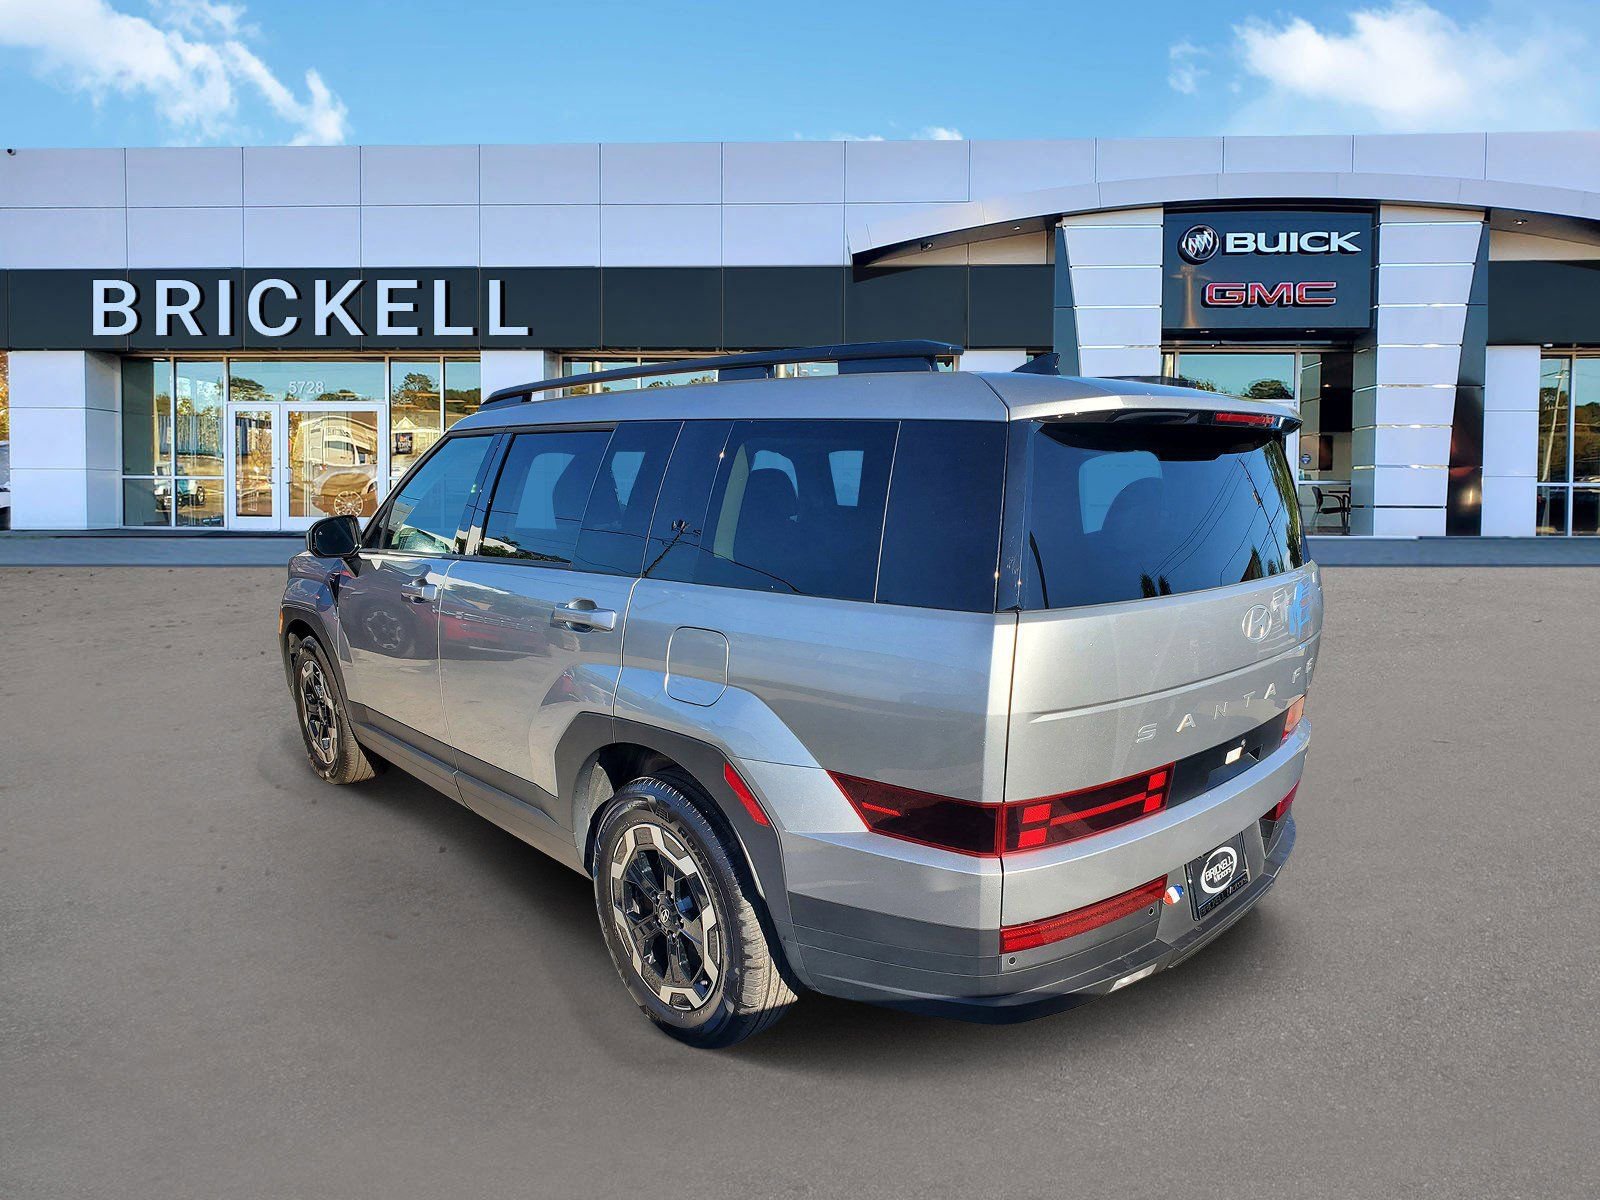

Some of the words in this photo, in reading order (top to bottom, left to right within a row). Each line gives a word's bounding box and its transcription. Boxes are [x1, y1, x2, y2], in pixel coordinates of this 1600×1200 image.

[1225, 231, 1362, 253] BUICK
[1205, 281, 1337, 305] GMC
[92, 278, 531, 337] BRICKELL
[288, 380, 325, 394] 5728
[1136, 682, 1277, 743] SANTA
[1291, 657, 1314, 684] FE
